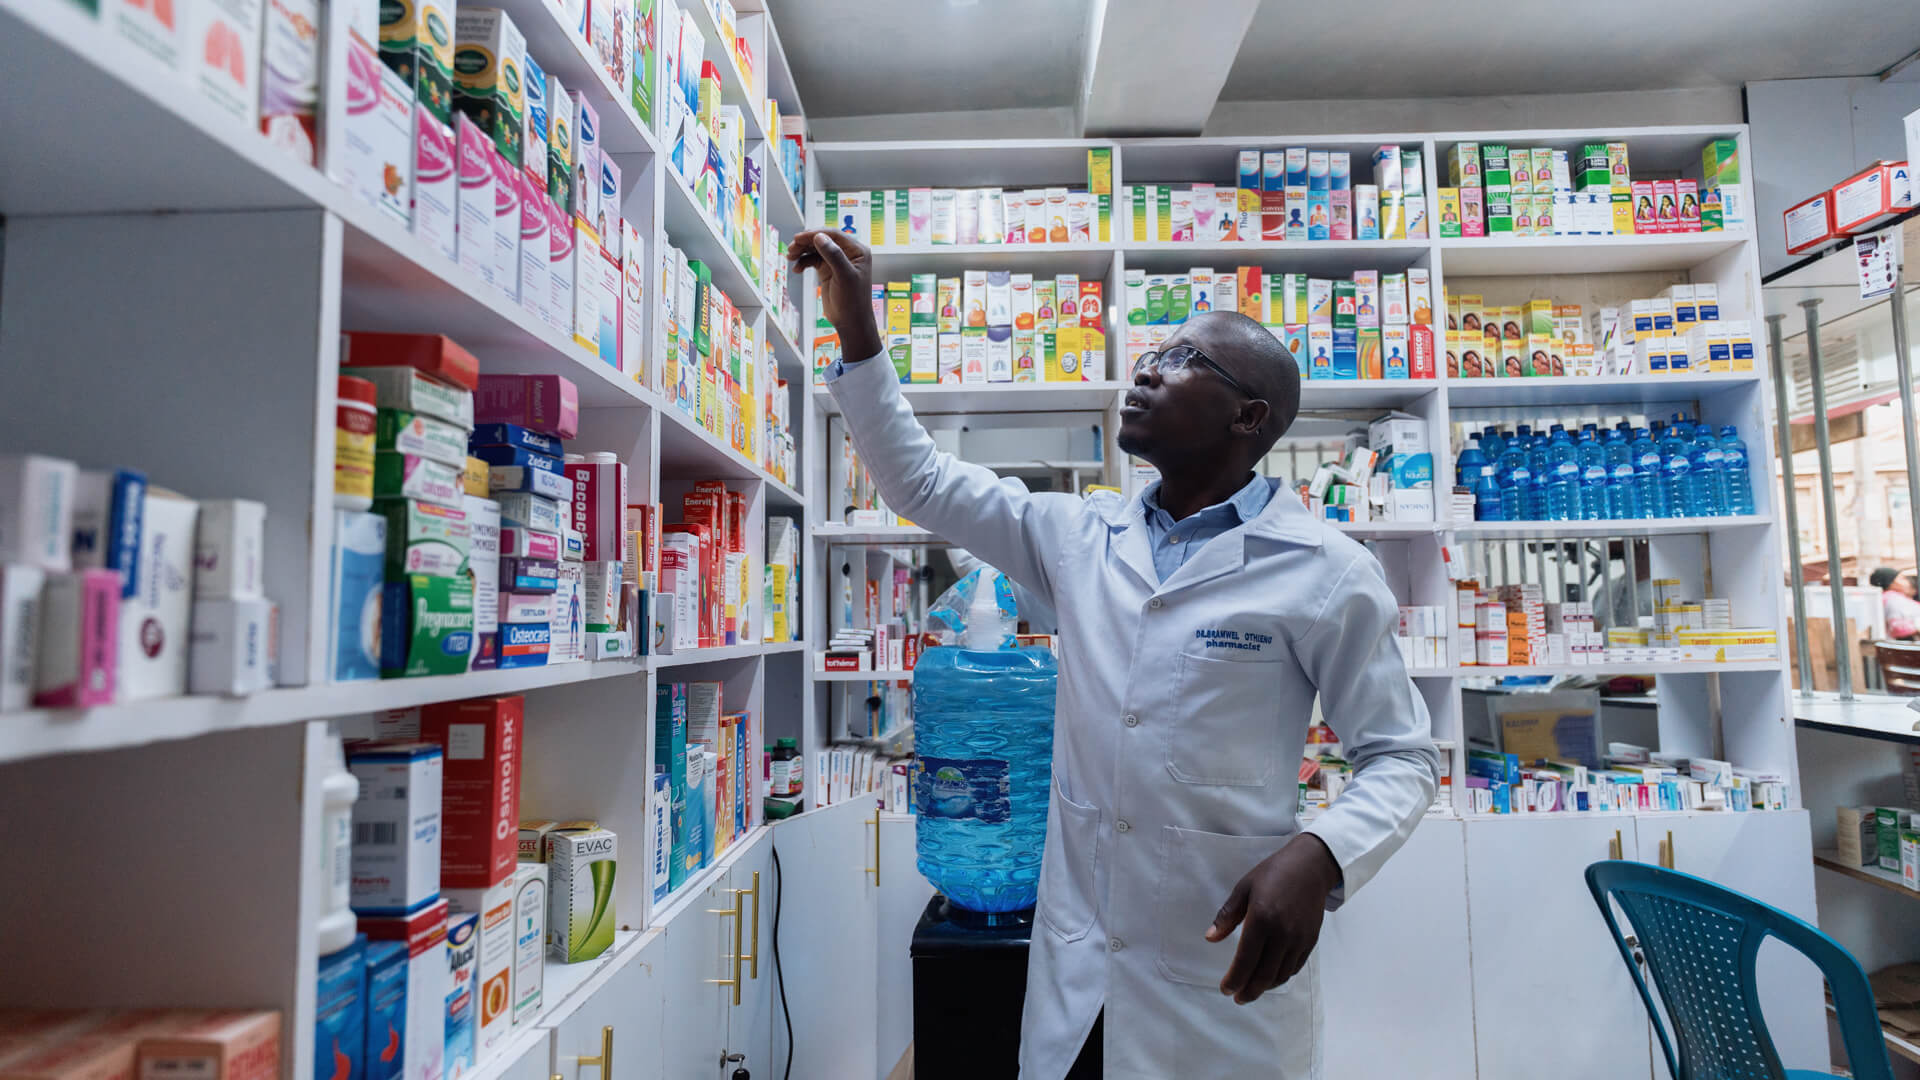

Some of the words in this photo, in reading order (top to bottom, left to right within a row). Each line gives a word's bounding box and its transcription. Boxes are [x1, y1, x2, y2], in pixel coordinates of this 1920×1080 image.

[696, 486, 722, 494] Enervit
[685, 498, 712, 506] Enervit
[510, 626, 550, 643] Osteocare
[1205, 639, 1262, 651] pharmacist
[497, 717, 515, 840] Osmolax
[576, 838, 613, 854] EVAC
